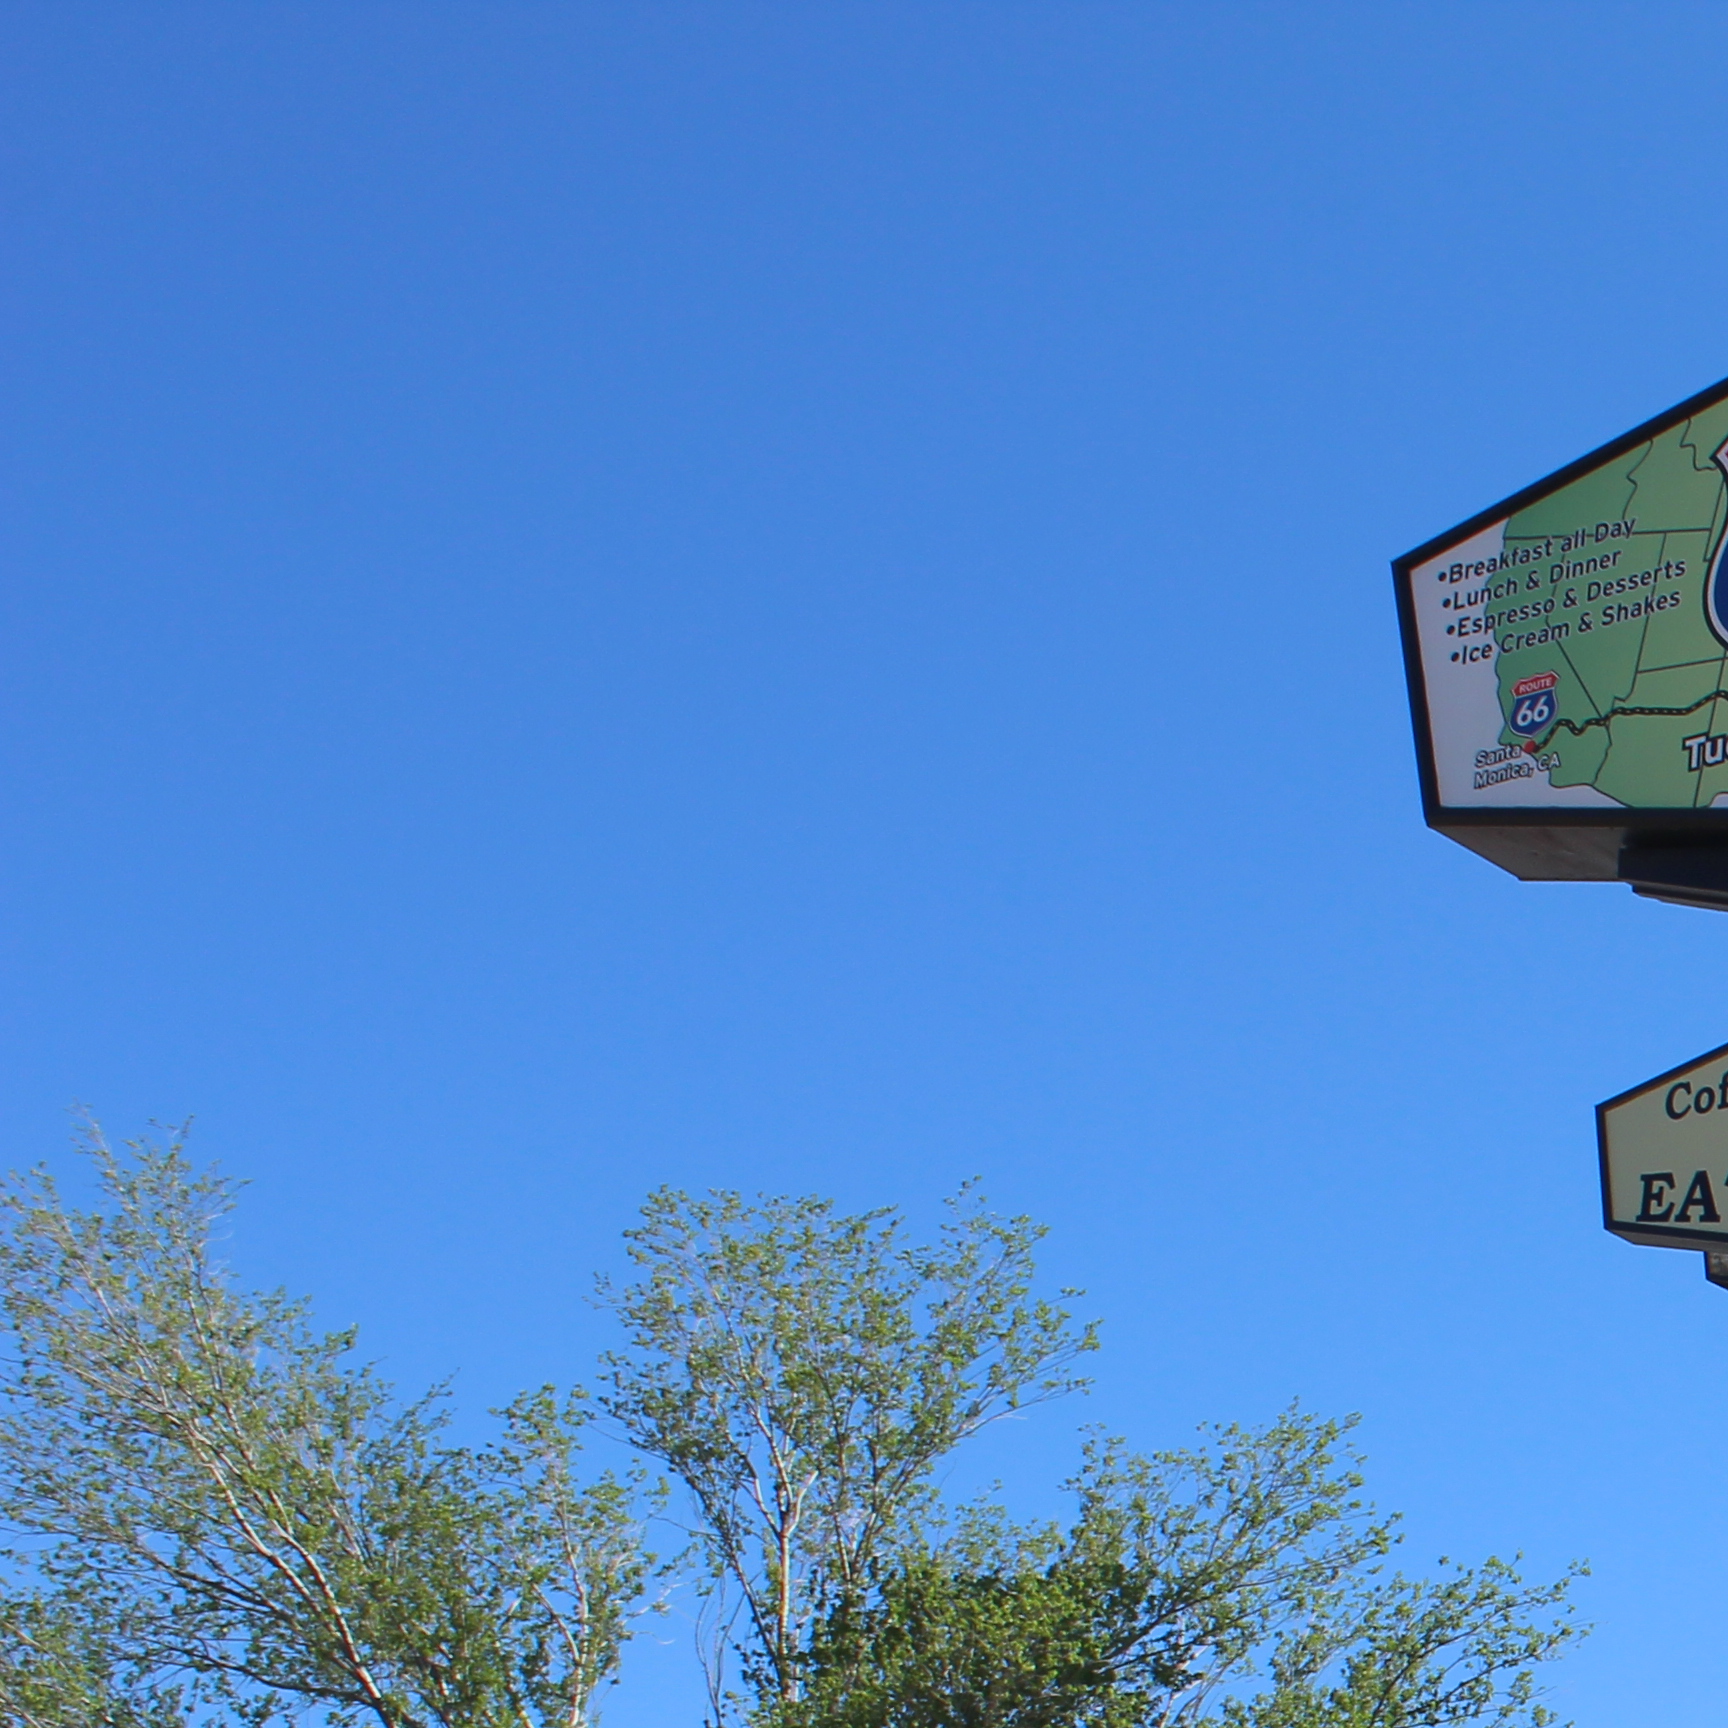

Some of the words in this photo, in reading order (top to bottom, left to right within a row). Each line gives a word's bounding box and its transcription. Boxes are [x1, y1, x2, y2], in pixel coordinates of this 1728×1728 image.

[1450, 538, 1552, 583] Breakfast
[1561, 528, 1586, 552] all
[1594, 517, 1636, 543] Day
[1454, 578, 1518, 610] Lunch
[1526, 571, 1540, 591] &
[1550, 550, 1622, 585] Dinner
[1457, 597, 1555, 637] Espresso
[1562, 588, 1578, 609] &
[1587, 560, 1687, 602] Desserts
[1461, 642, 1493, 665] Ice
[1501, 623, 1570, 654] Cream
[1577, 613, 1593, 633] &
[1601, 591, 1682, 627] Shakes
[1519, 677, 1553, 694] ROUTE
[1517, 695, 1550, 727] 66
[1474, 763, 1535, 790] Monica,
[1537, 751, 1561, 772] CA
[1475, 746, 1522, 768] Santa
